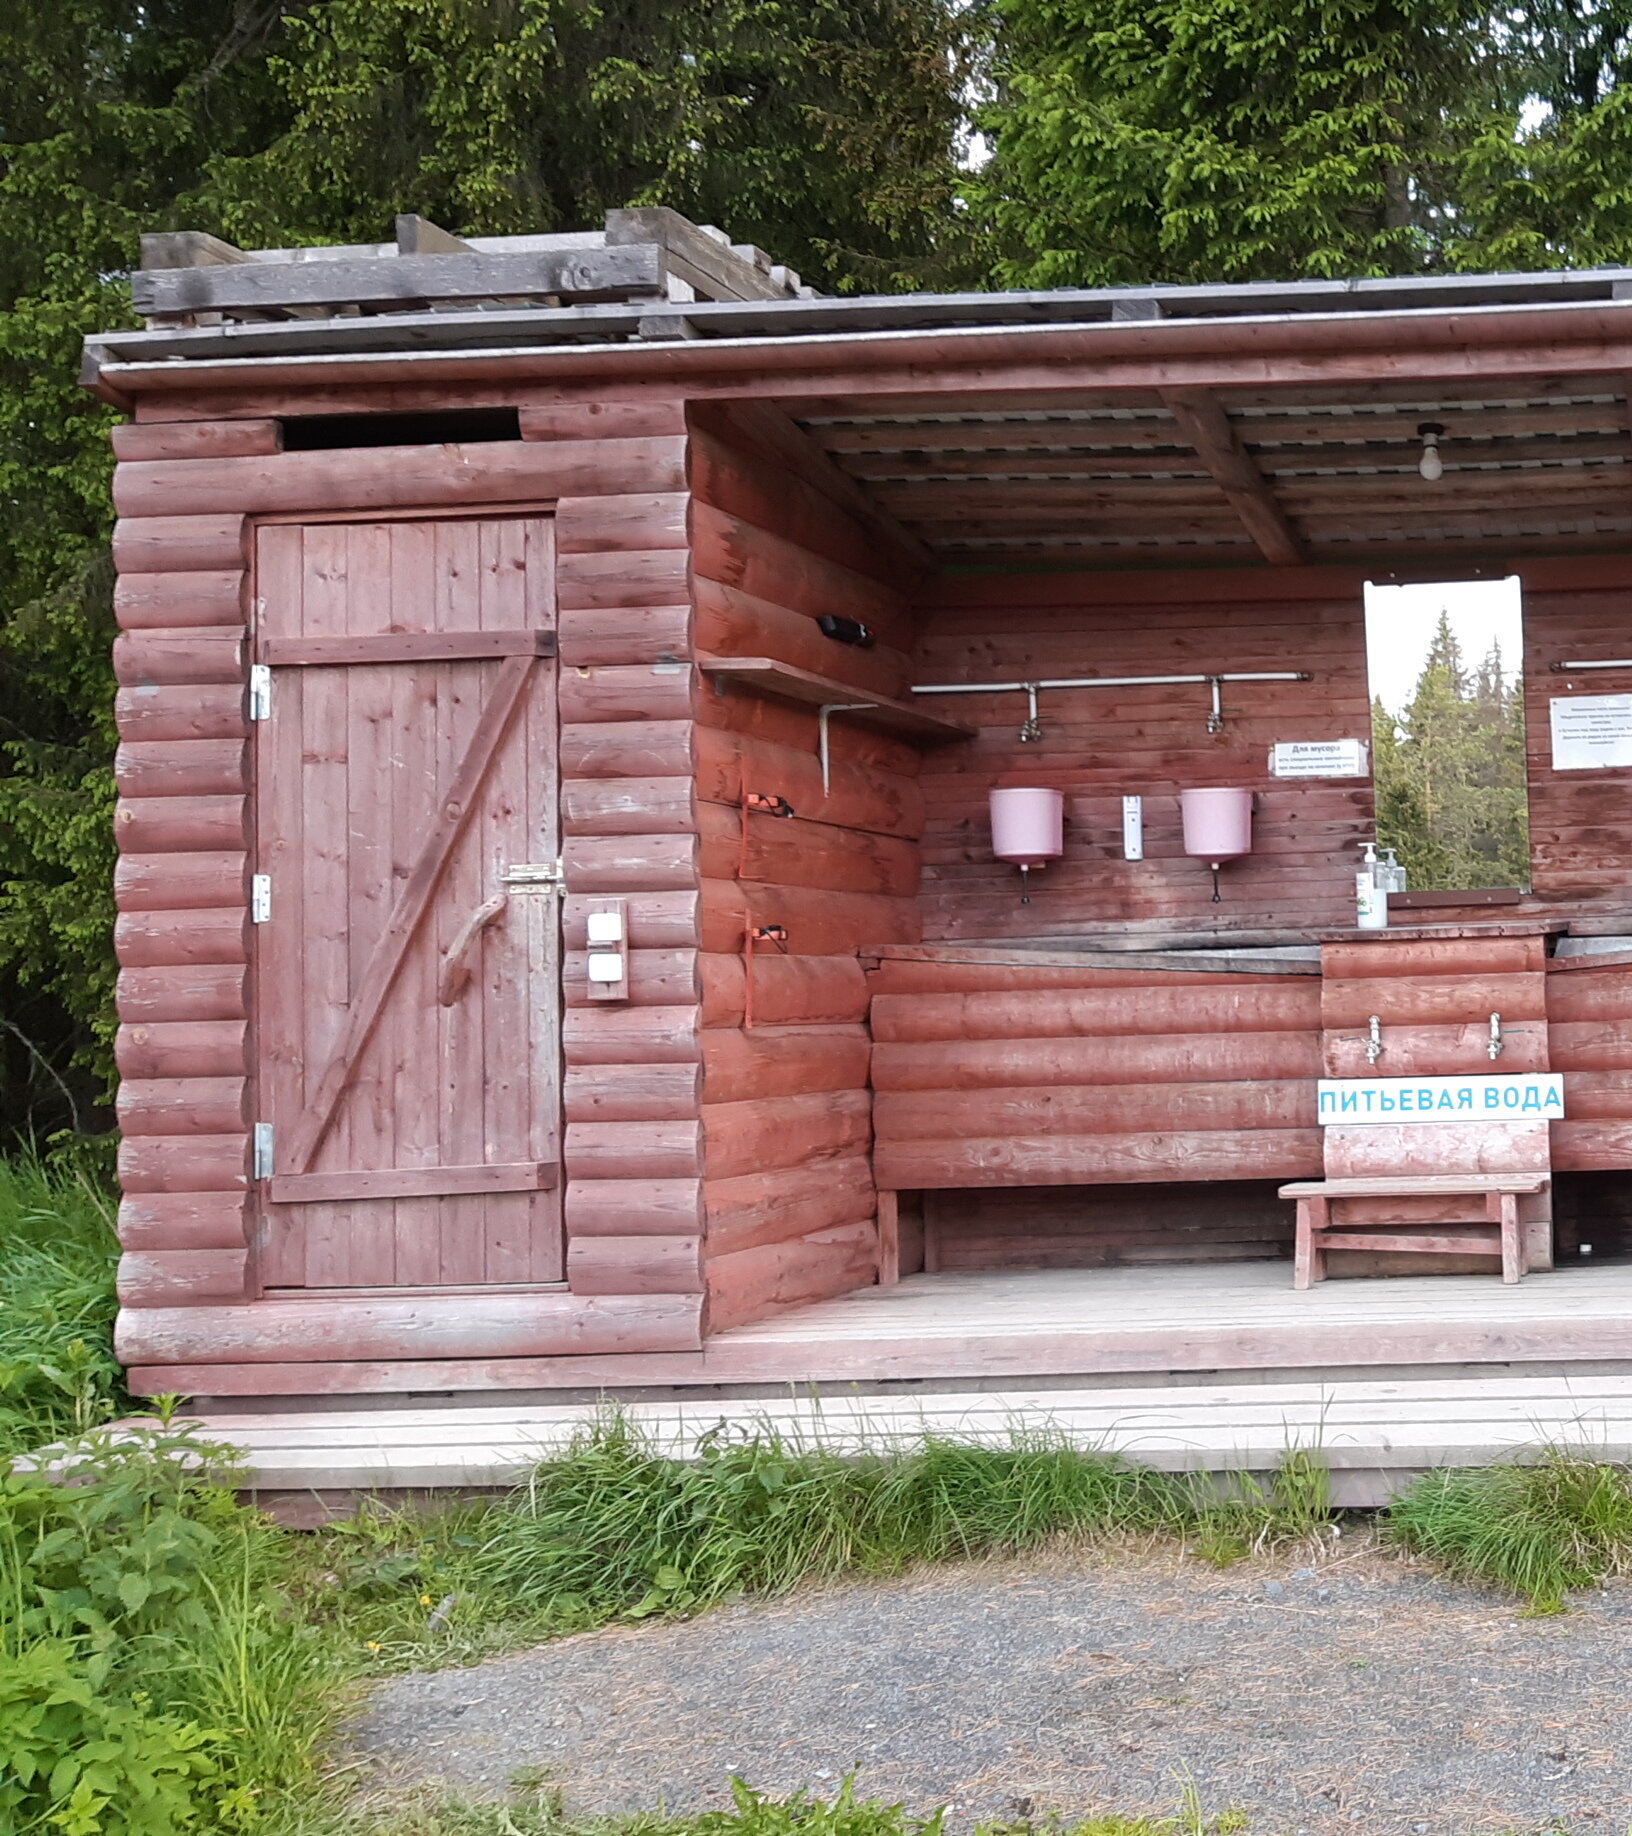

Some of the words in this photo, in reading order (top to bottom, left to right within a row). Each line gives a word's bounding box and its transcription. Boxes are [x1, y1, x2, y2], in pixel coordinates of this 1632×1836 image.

[1292, 745, 1309, 753] Для
[1310, 745, 1340, 753] мусора
[1320, 1088, 1473, 1112] ПИТЬЕВАЯ
[1484, 1086, 1562, 1111] ВОДА
